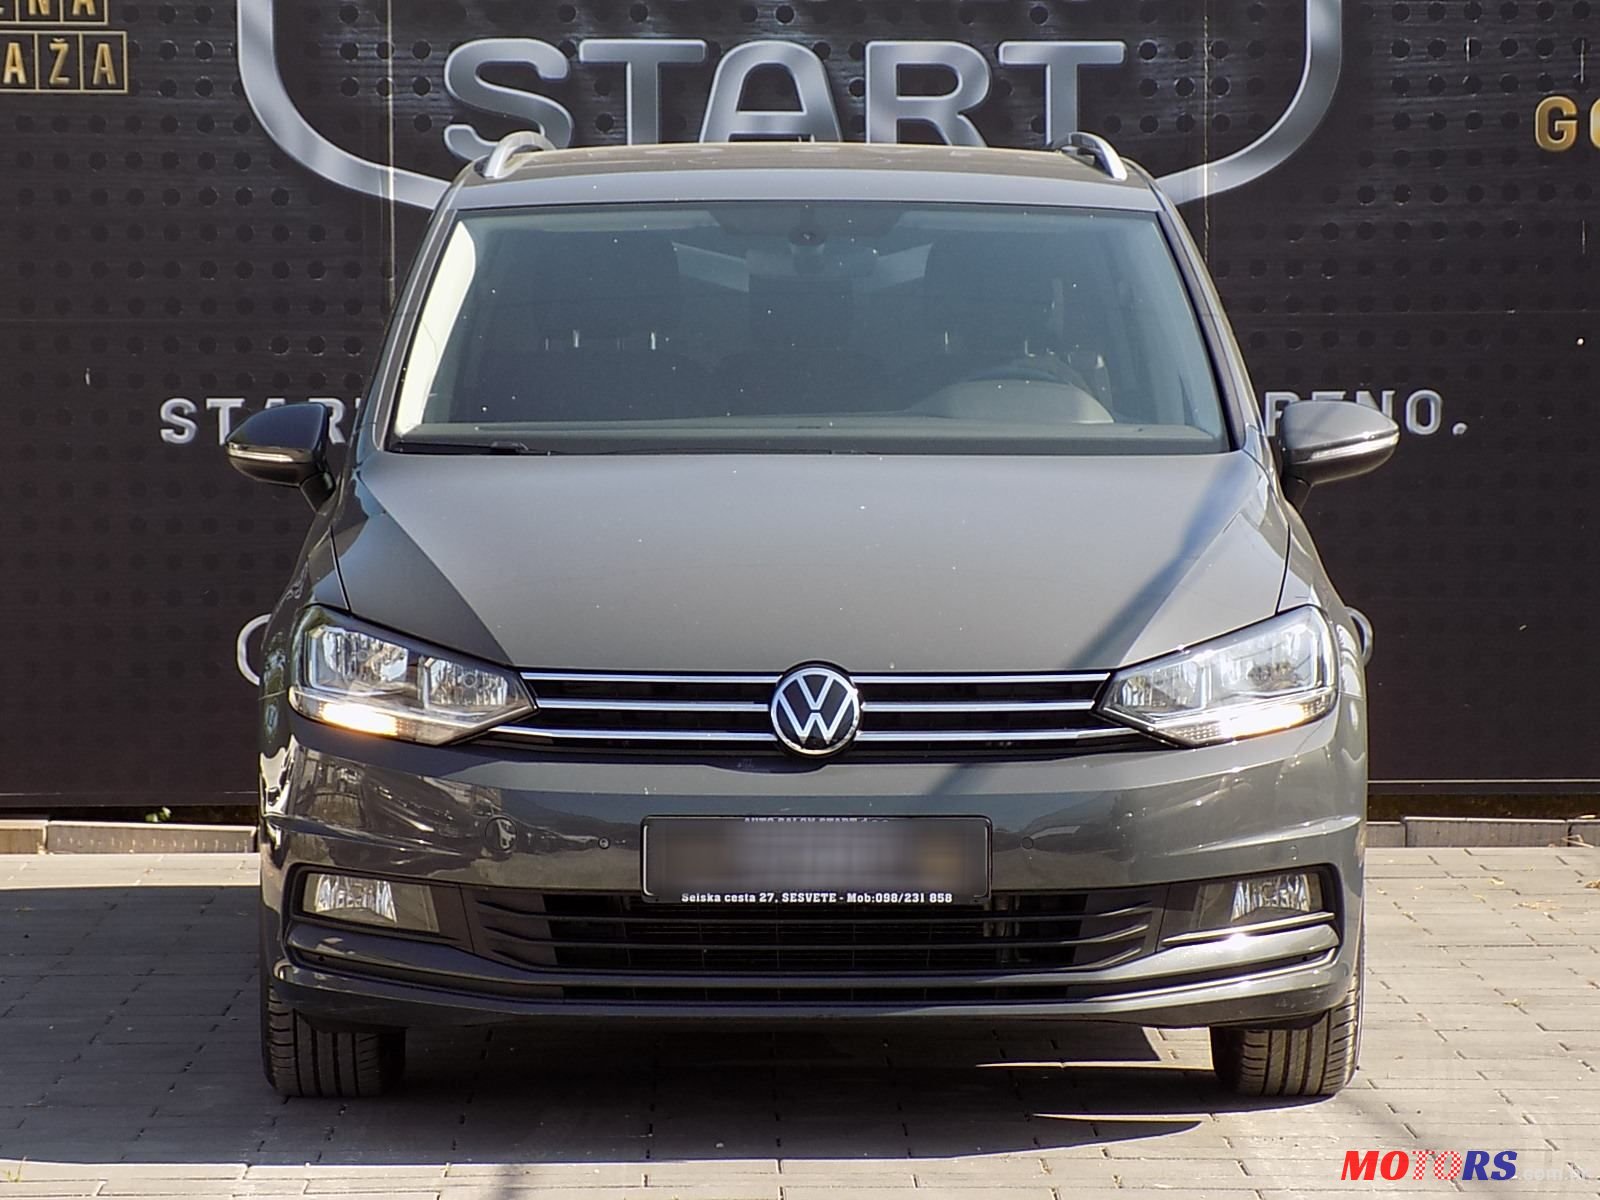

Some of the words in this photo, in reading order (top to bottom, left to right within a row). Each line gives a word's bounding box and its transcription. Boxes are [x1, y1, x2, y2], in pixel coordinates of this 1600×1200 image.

[443, 38, 1126, 160] START
[1535, 95, 1600, 151] G
[159, 397, 361, 445] STR
[724, 893, 756, 903] cesta
[781, 892, 837, 903] SESVETE
[846, 892, 926, 903] Mob:098/231
[929, 892, 953, 903] 858
